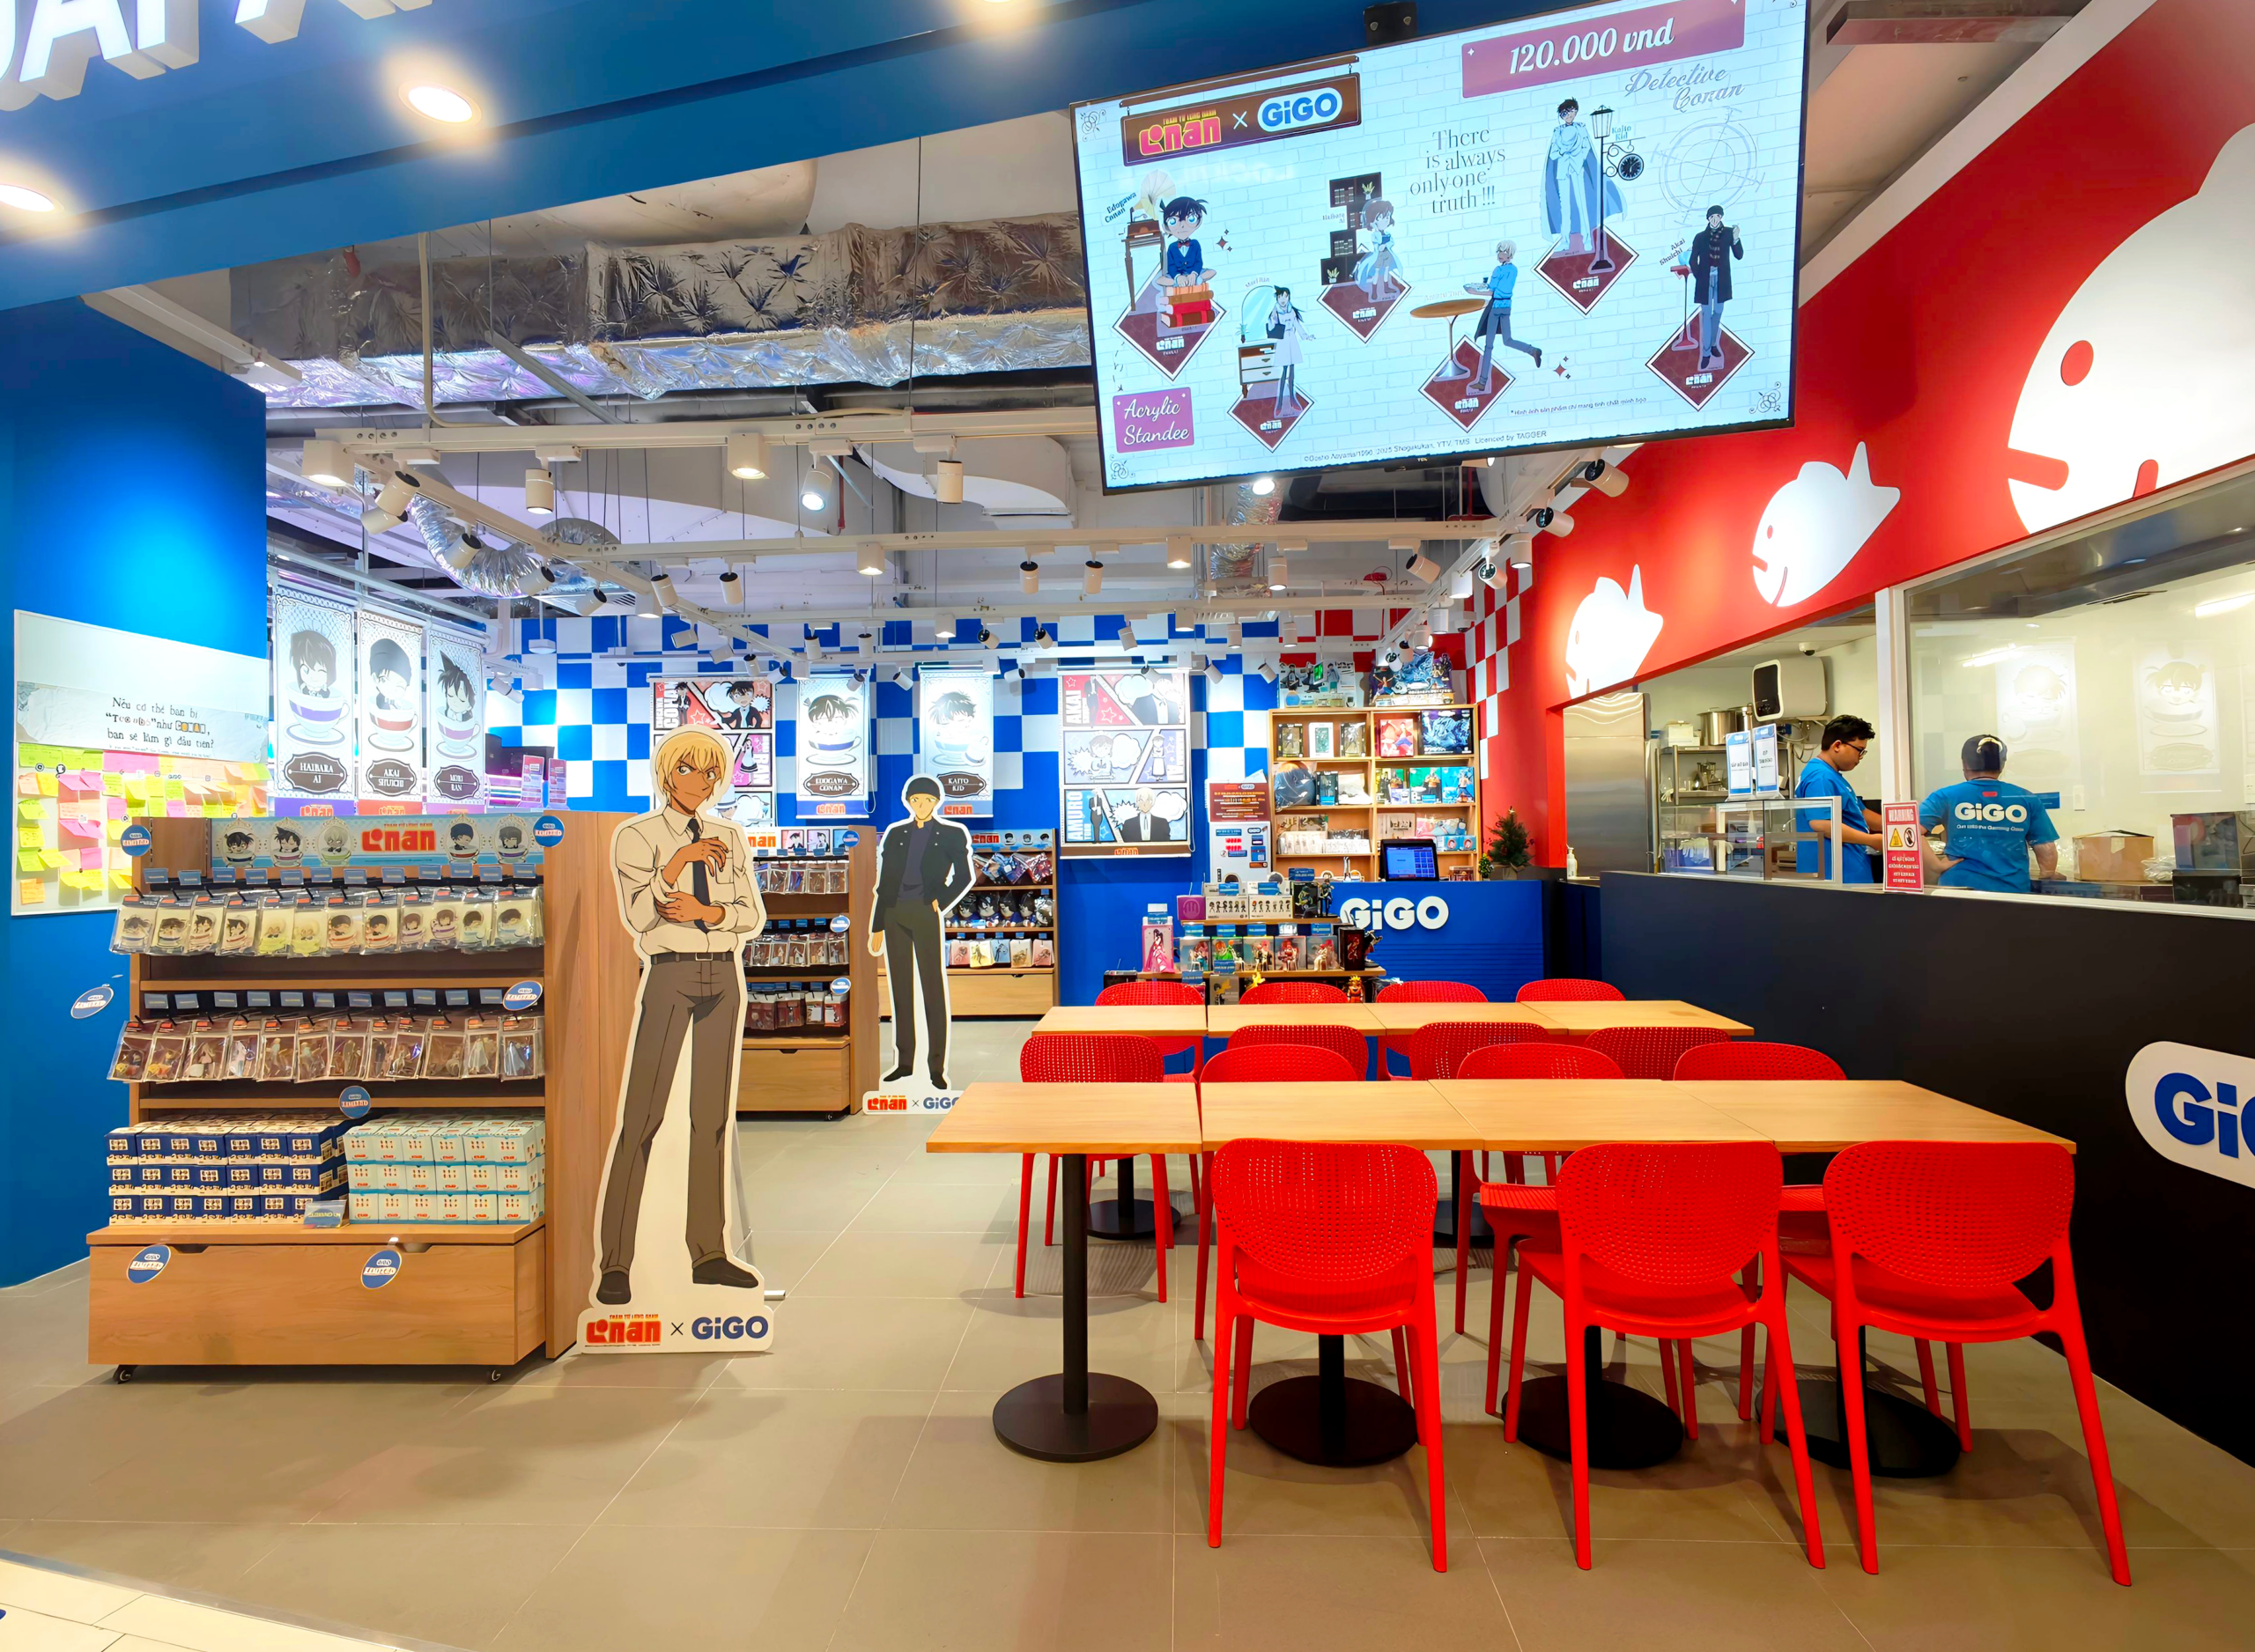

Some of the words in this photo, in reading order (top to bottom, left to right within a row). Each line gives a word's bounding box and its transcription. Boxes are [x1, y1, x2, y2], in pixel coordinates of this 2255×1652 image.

[1510, 27, 1617, 75] 120.000
[1623, 18, 1675, 53] vnd
[1625, 63, 1729, 97] Detective
[1261, 92, 1338, 127] GiGO
[1673, 82, 1746, 113] Conan
[1432, 127, 1490, 151] There
[1425, 150, 1440, 169] is
[1445, 145, 1506, 172] always
[1409, 171, 1450, 197] only
[1452, 172, 1488, 188] one
[1105, 206, 1127, 224] Conan
[1106, 191, 1137, 213] Edogawa
[1431, 191, 1478, 215] truth
[1124, 395, 1180, 422] Acrylic
[1124, 421, 1190, 446] Standee
[299, 762, 334, 774] HAIBARA
[1067, 790, 1083, 840] AMURO
[1955, 802, 2028, 822] GiGO
[1340, 896, 1449, 931] GiGO
[691, 1316, 769, 1340] GiGO
